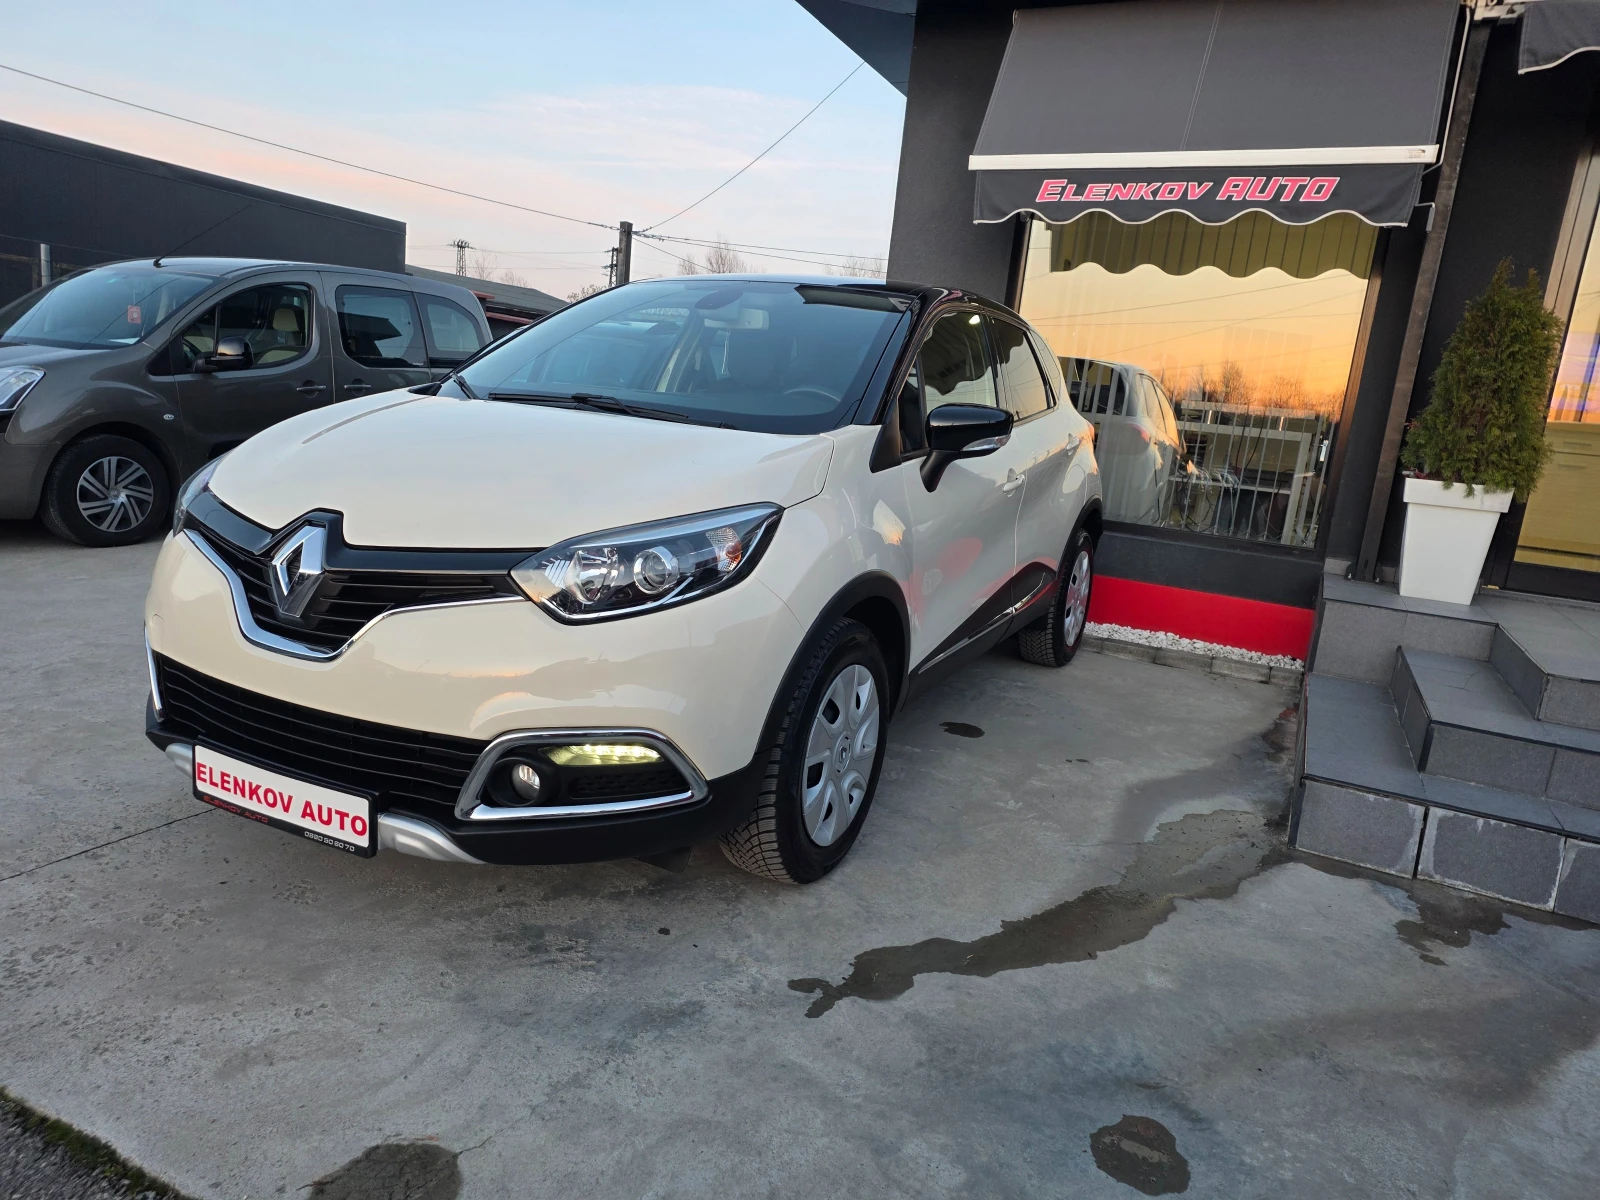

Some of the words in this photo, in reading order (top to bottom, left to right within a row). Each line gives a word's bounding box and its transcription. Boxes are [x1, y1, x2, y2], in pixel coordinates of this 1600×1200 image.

[1216, 176, 1340, 202] AUTO
[196, 761, 293, 814] ELENKOV
[300, 799, 368, 837] AUTO
